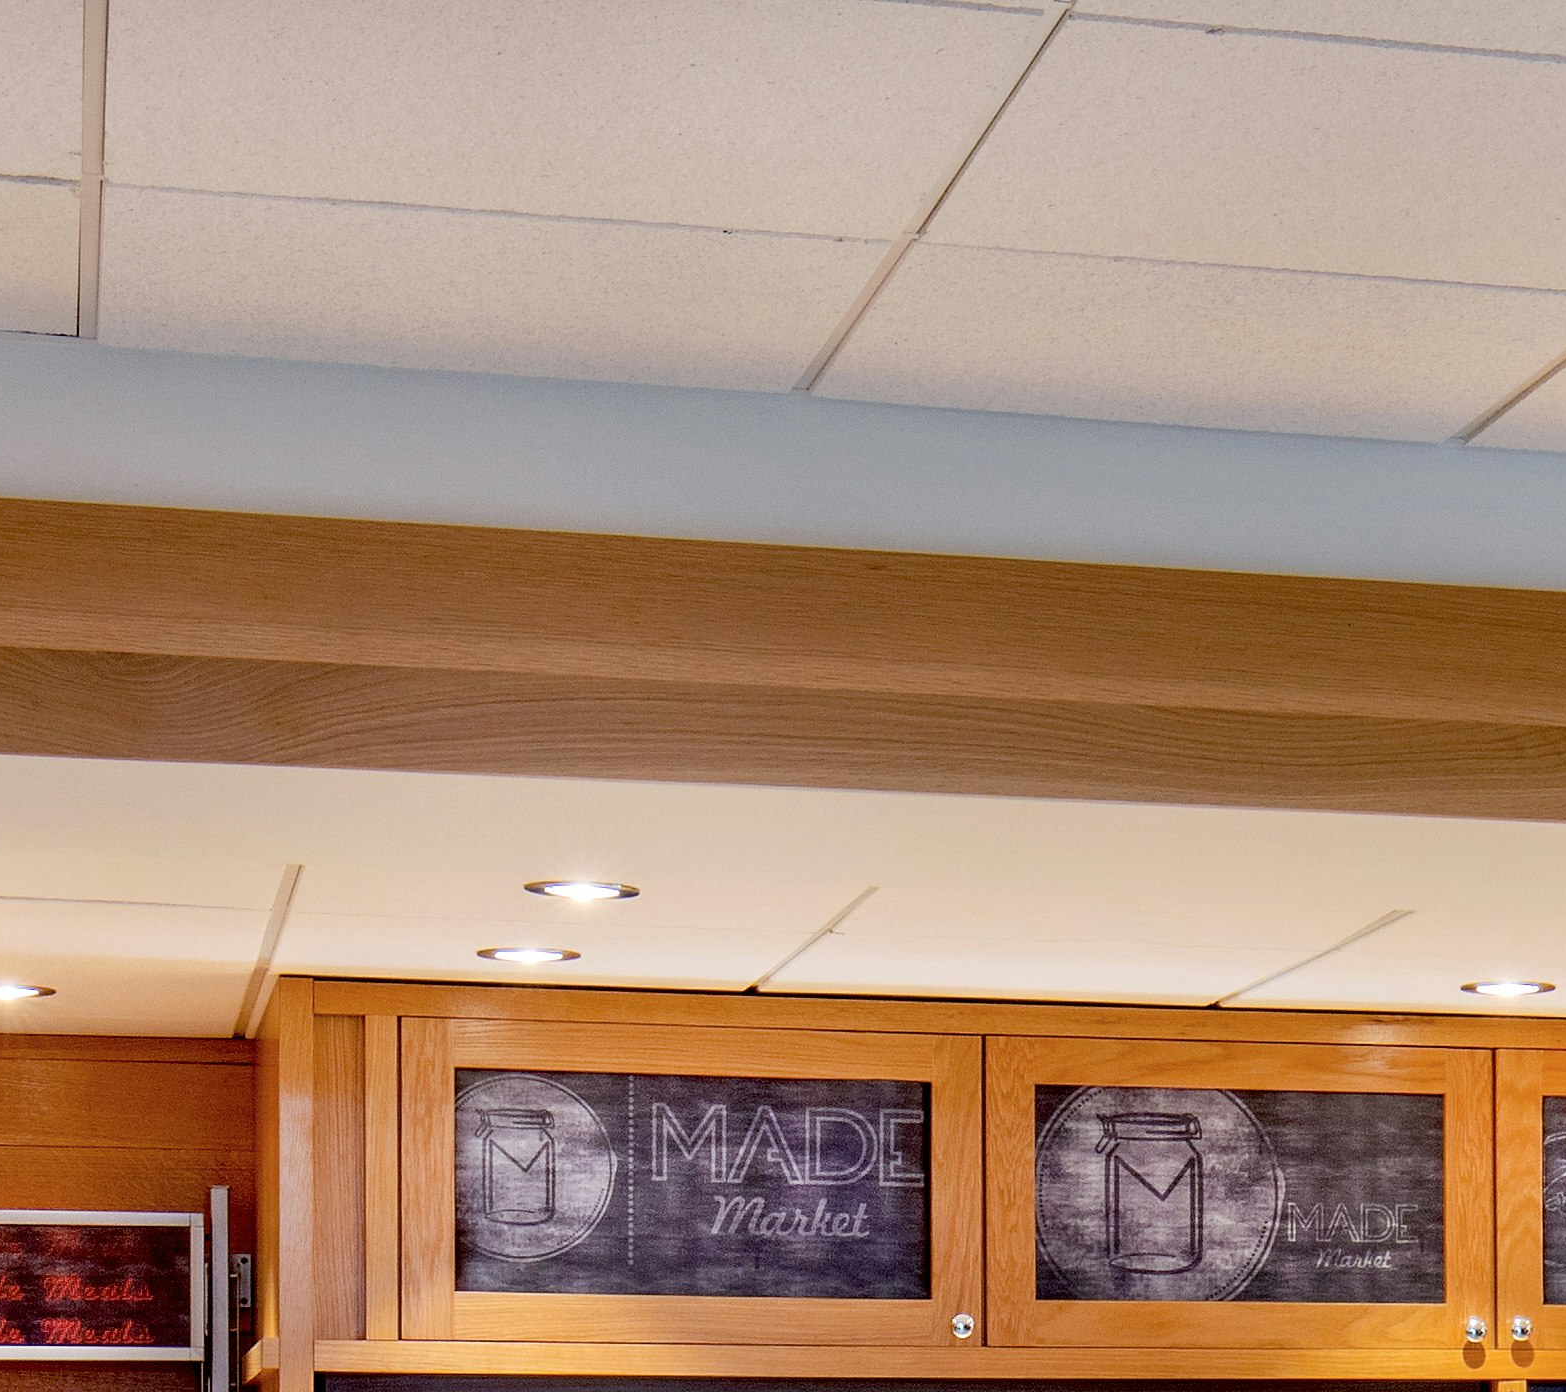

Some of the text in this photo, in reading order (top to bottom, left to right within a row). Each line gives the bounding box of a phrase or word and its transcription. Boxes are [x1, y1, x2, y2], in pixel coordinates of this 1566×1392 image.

[651, 1103, 924, 1188] MADE
[711, 1193, 871, 1239] Market
[1287, 1202, 1419, 1245] MADE
[1316, 1247, 1392, 1271] Market
